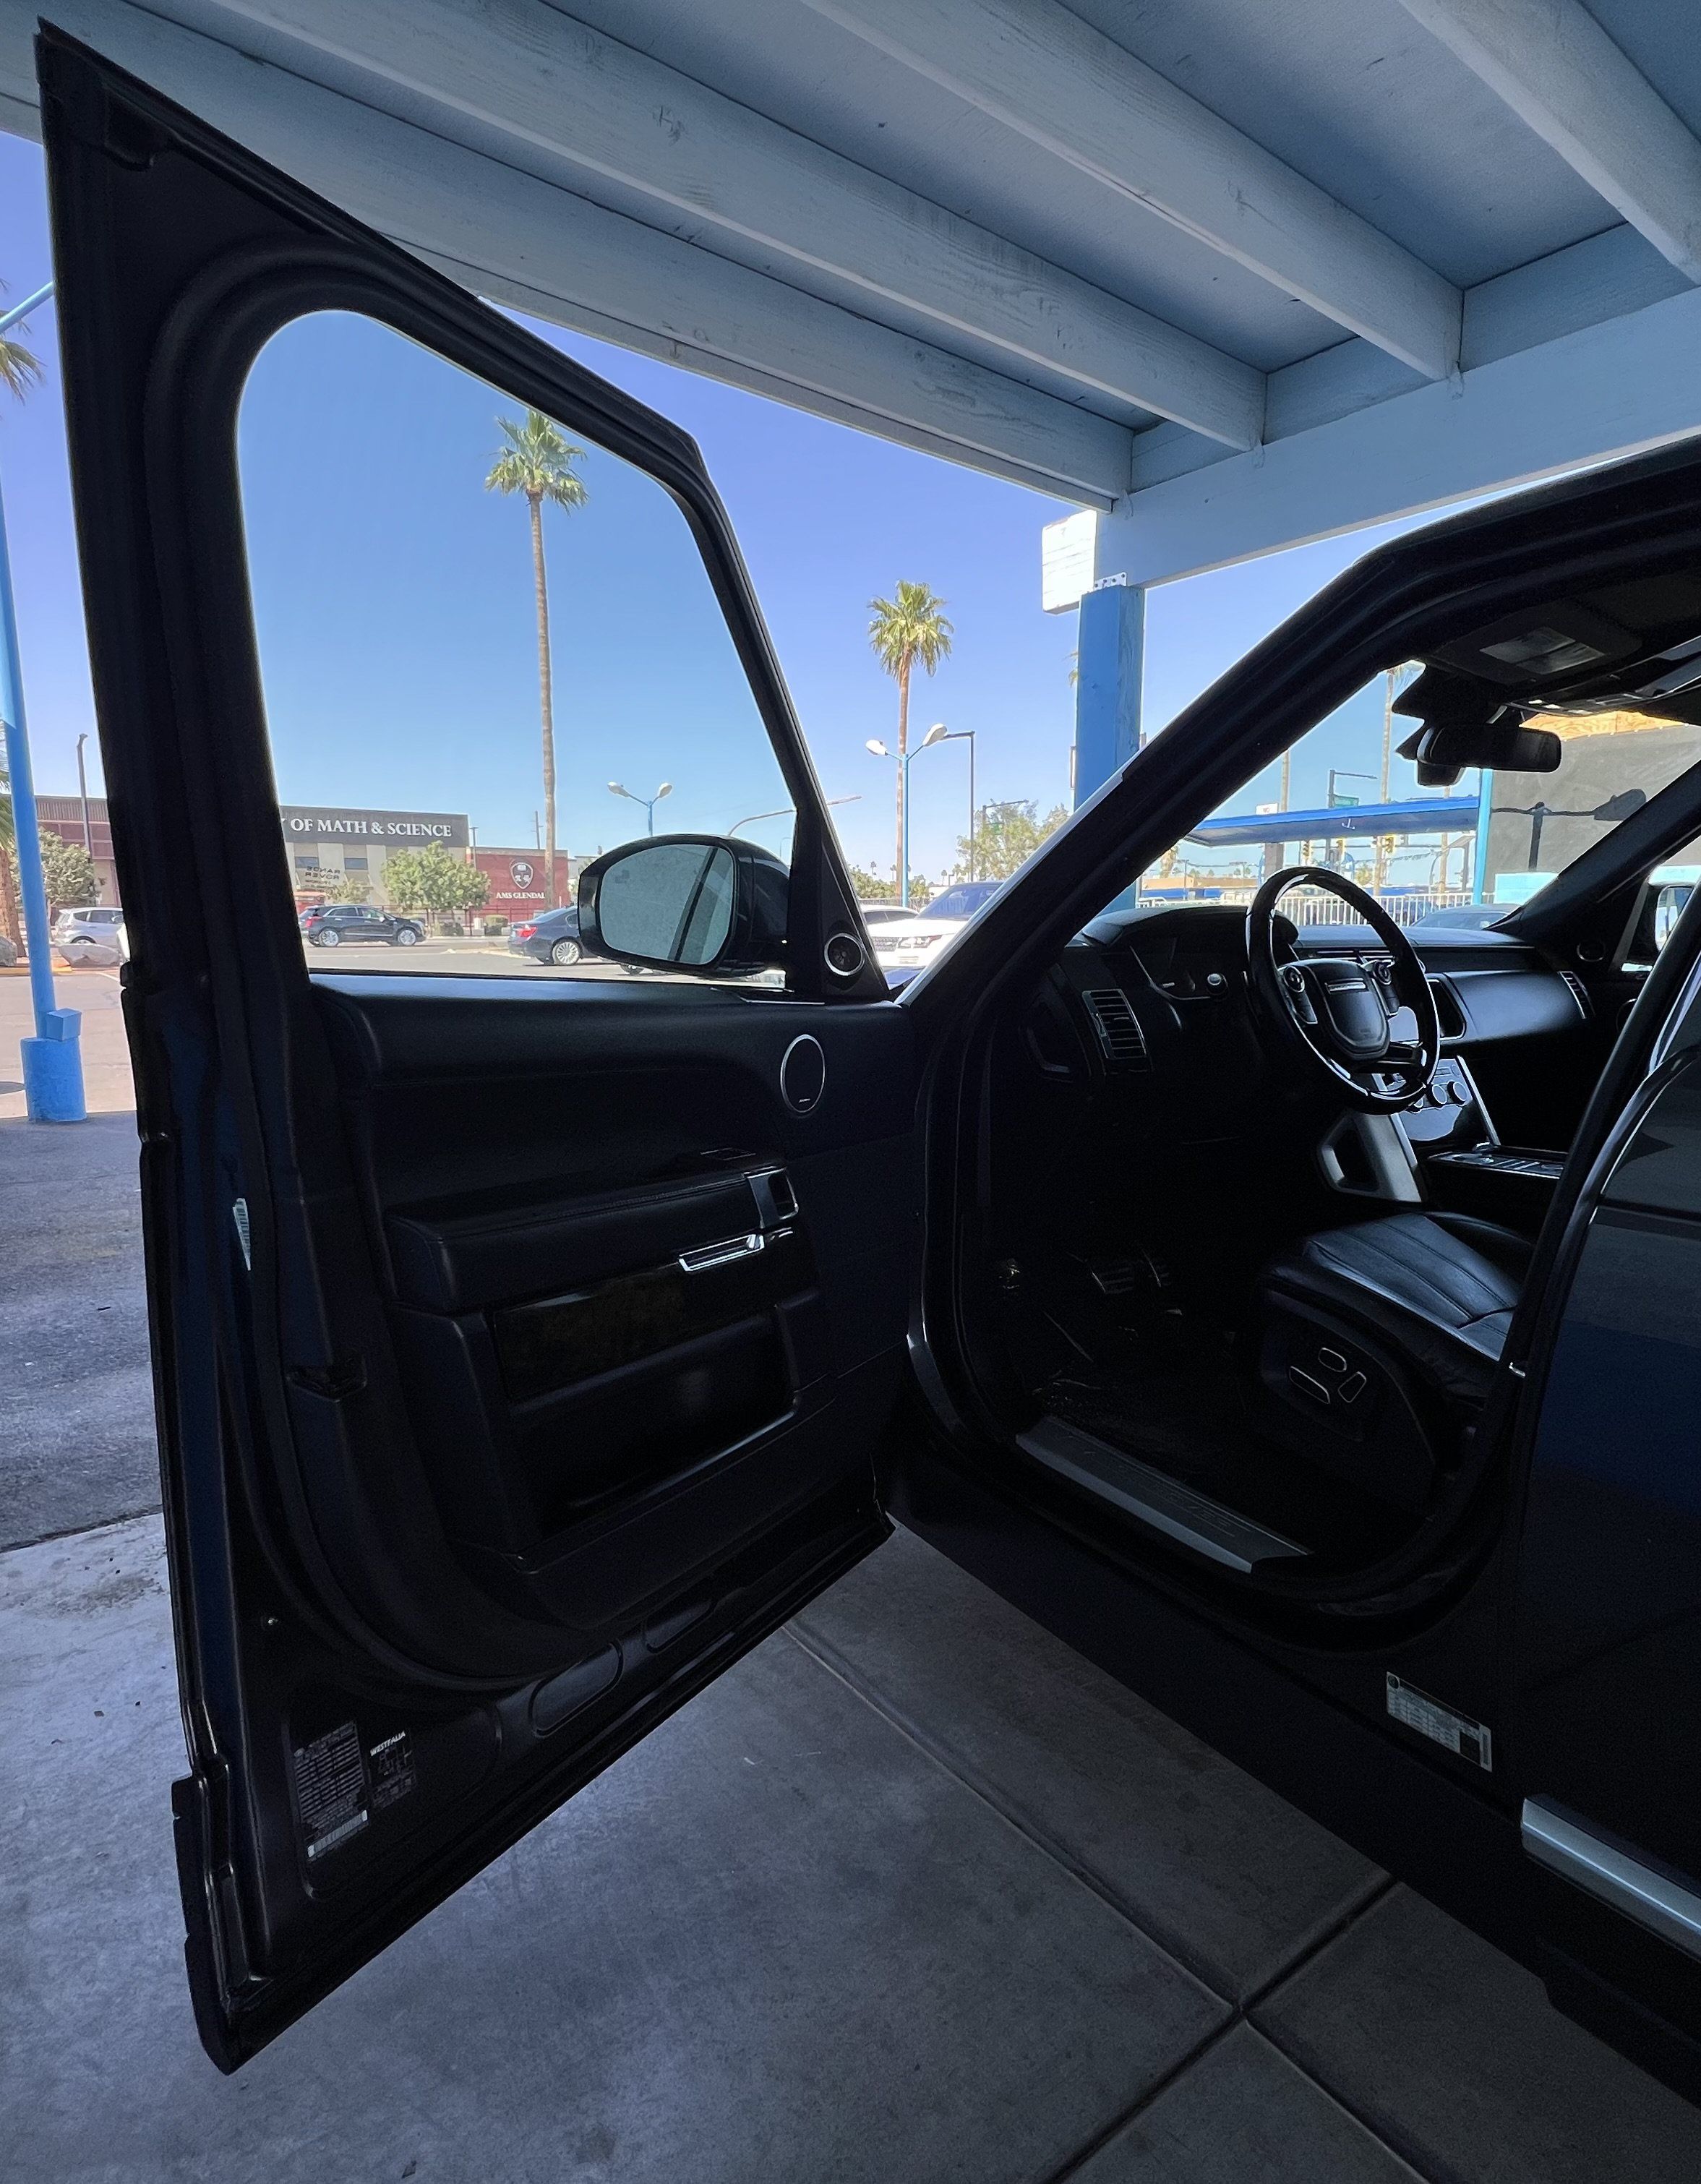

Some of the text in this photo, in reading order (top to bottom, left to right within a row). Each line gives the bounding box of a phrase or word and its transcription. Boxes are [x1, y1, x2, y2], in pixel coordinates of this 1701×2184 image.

[290, 818, 313, 831] OF
[317, 819, 368, 834] MATH
[371, 822, 385, 835] &
[387, 823, 452, 837] SCIENCE
